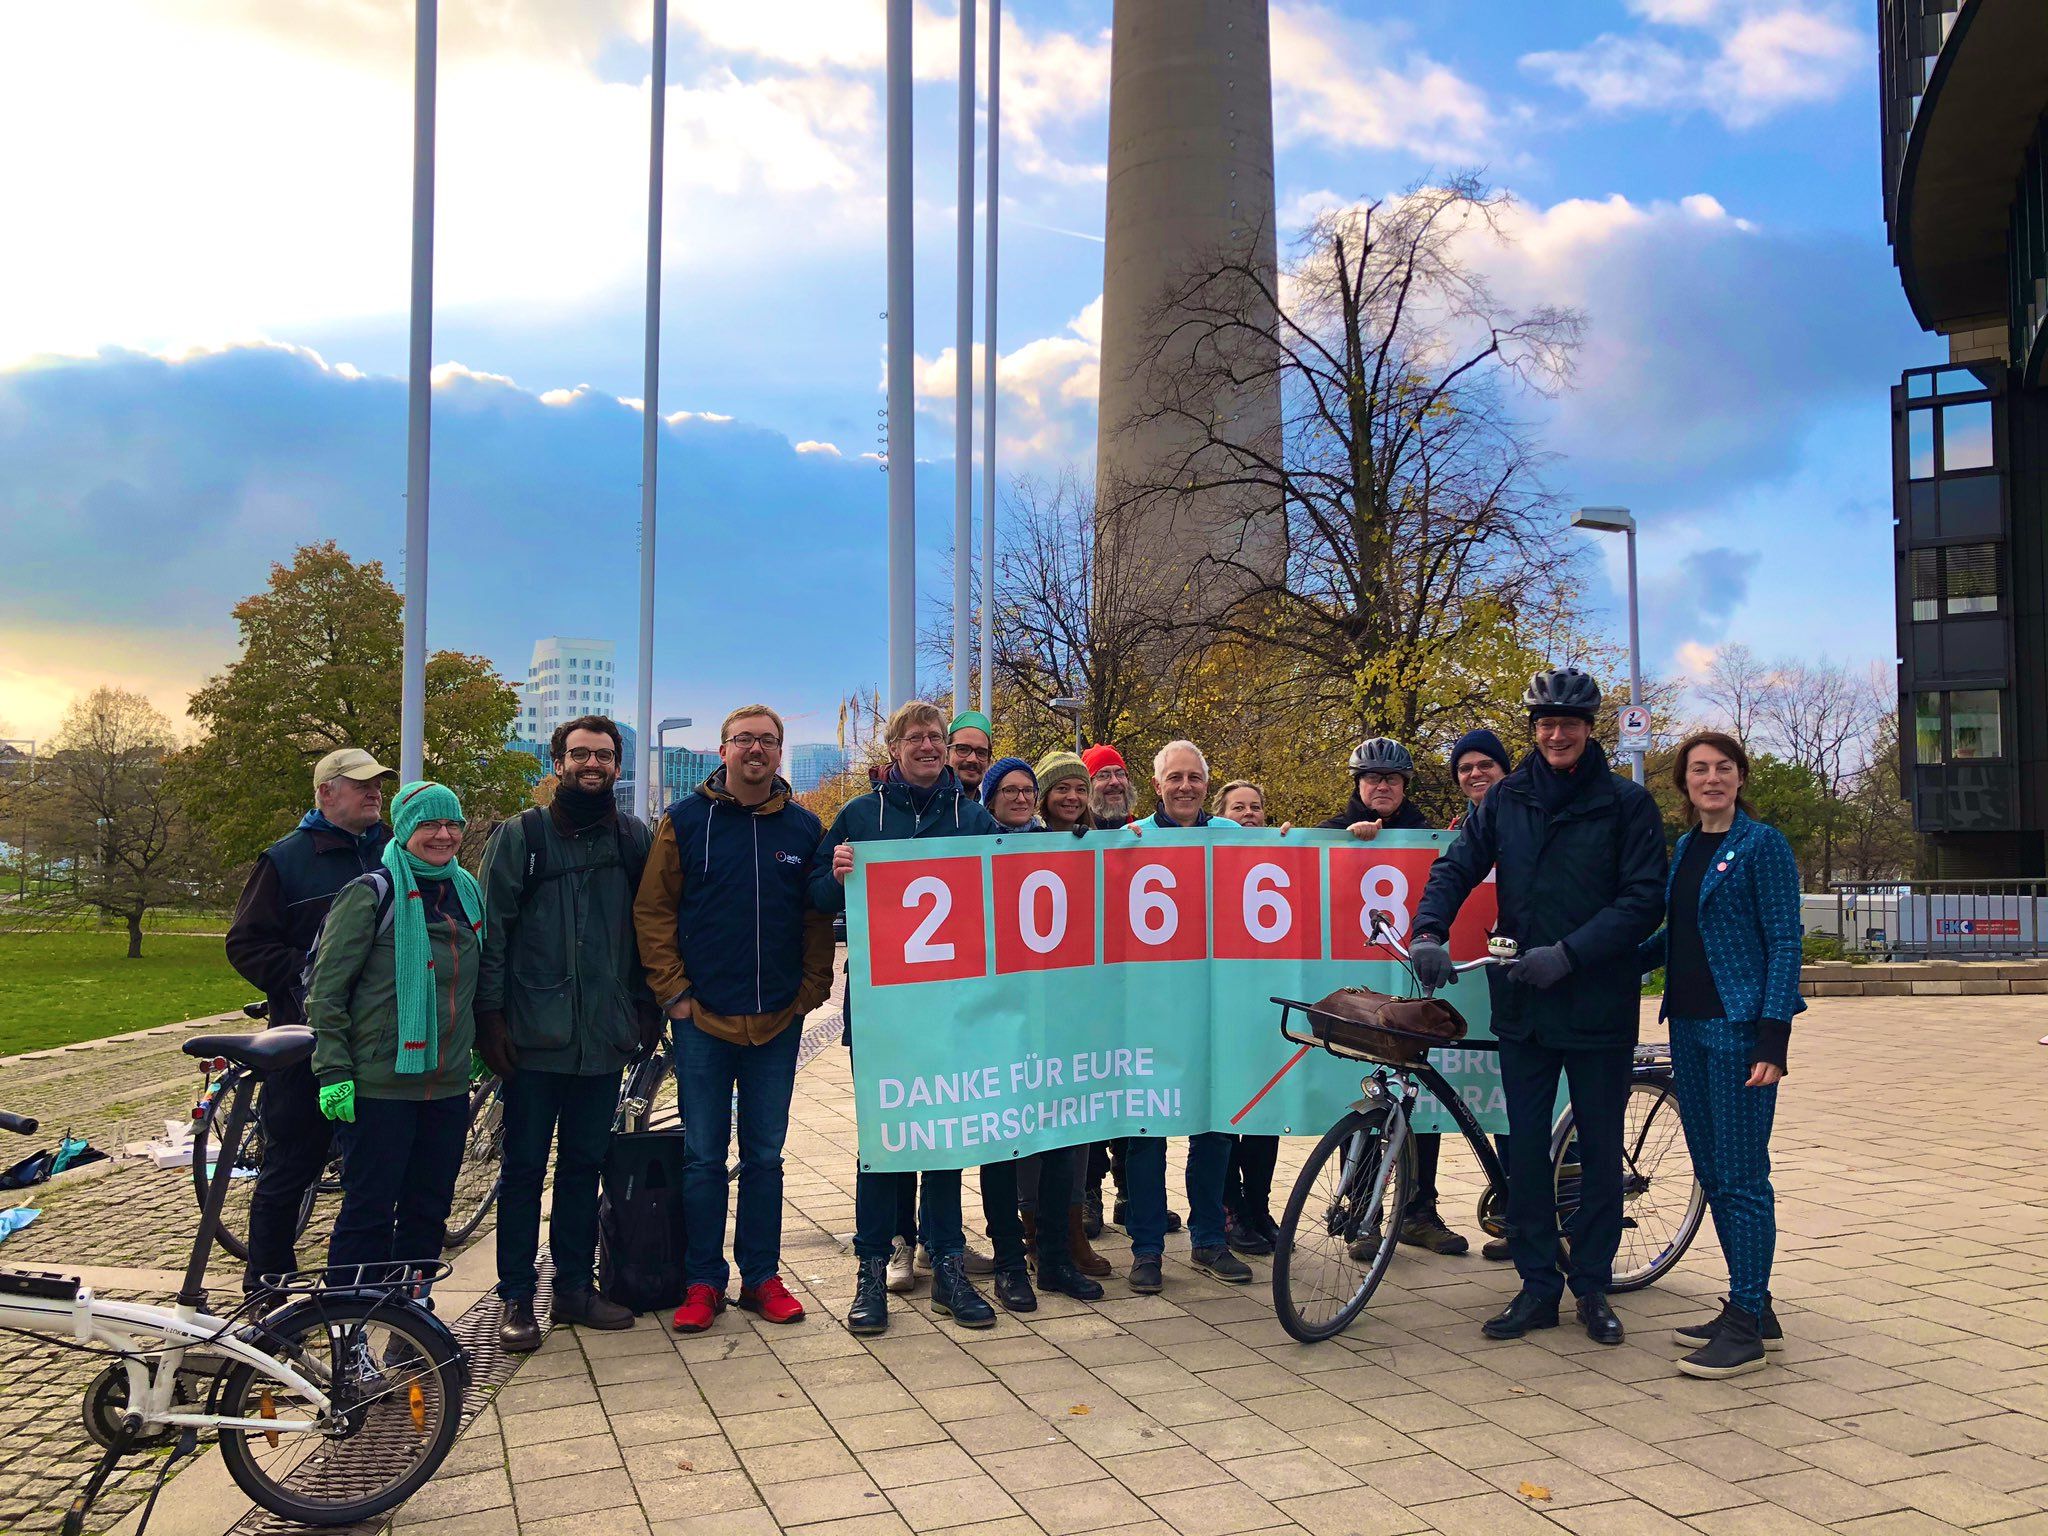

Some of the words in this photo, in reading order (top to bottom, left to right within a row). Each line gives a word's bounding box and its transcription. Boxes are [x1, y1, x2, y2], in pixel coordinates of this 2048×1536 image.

[786, 853, 802, 864] adfc
[878, 1066, 1001, 1109] DANKE
[1010, 1053, 1063, 1094] FÜR
[1072, 1047, 1154, 1083] EURE
[880, 1088, 1182, 1152] UNTERSCHRIFTEN!
